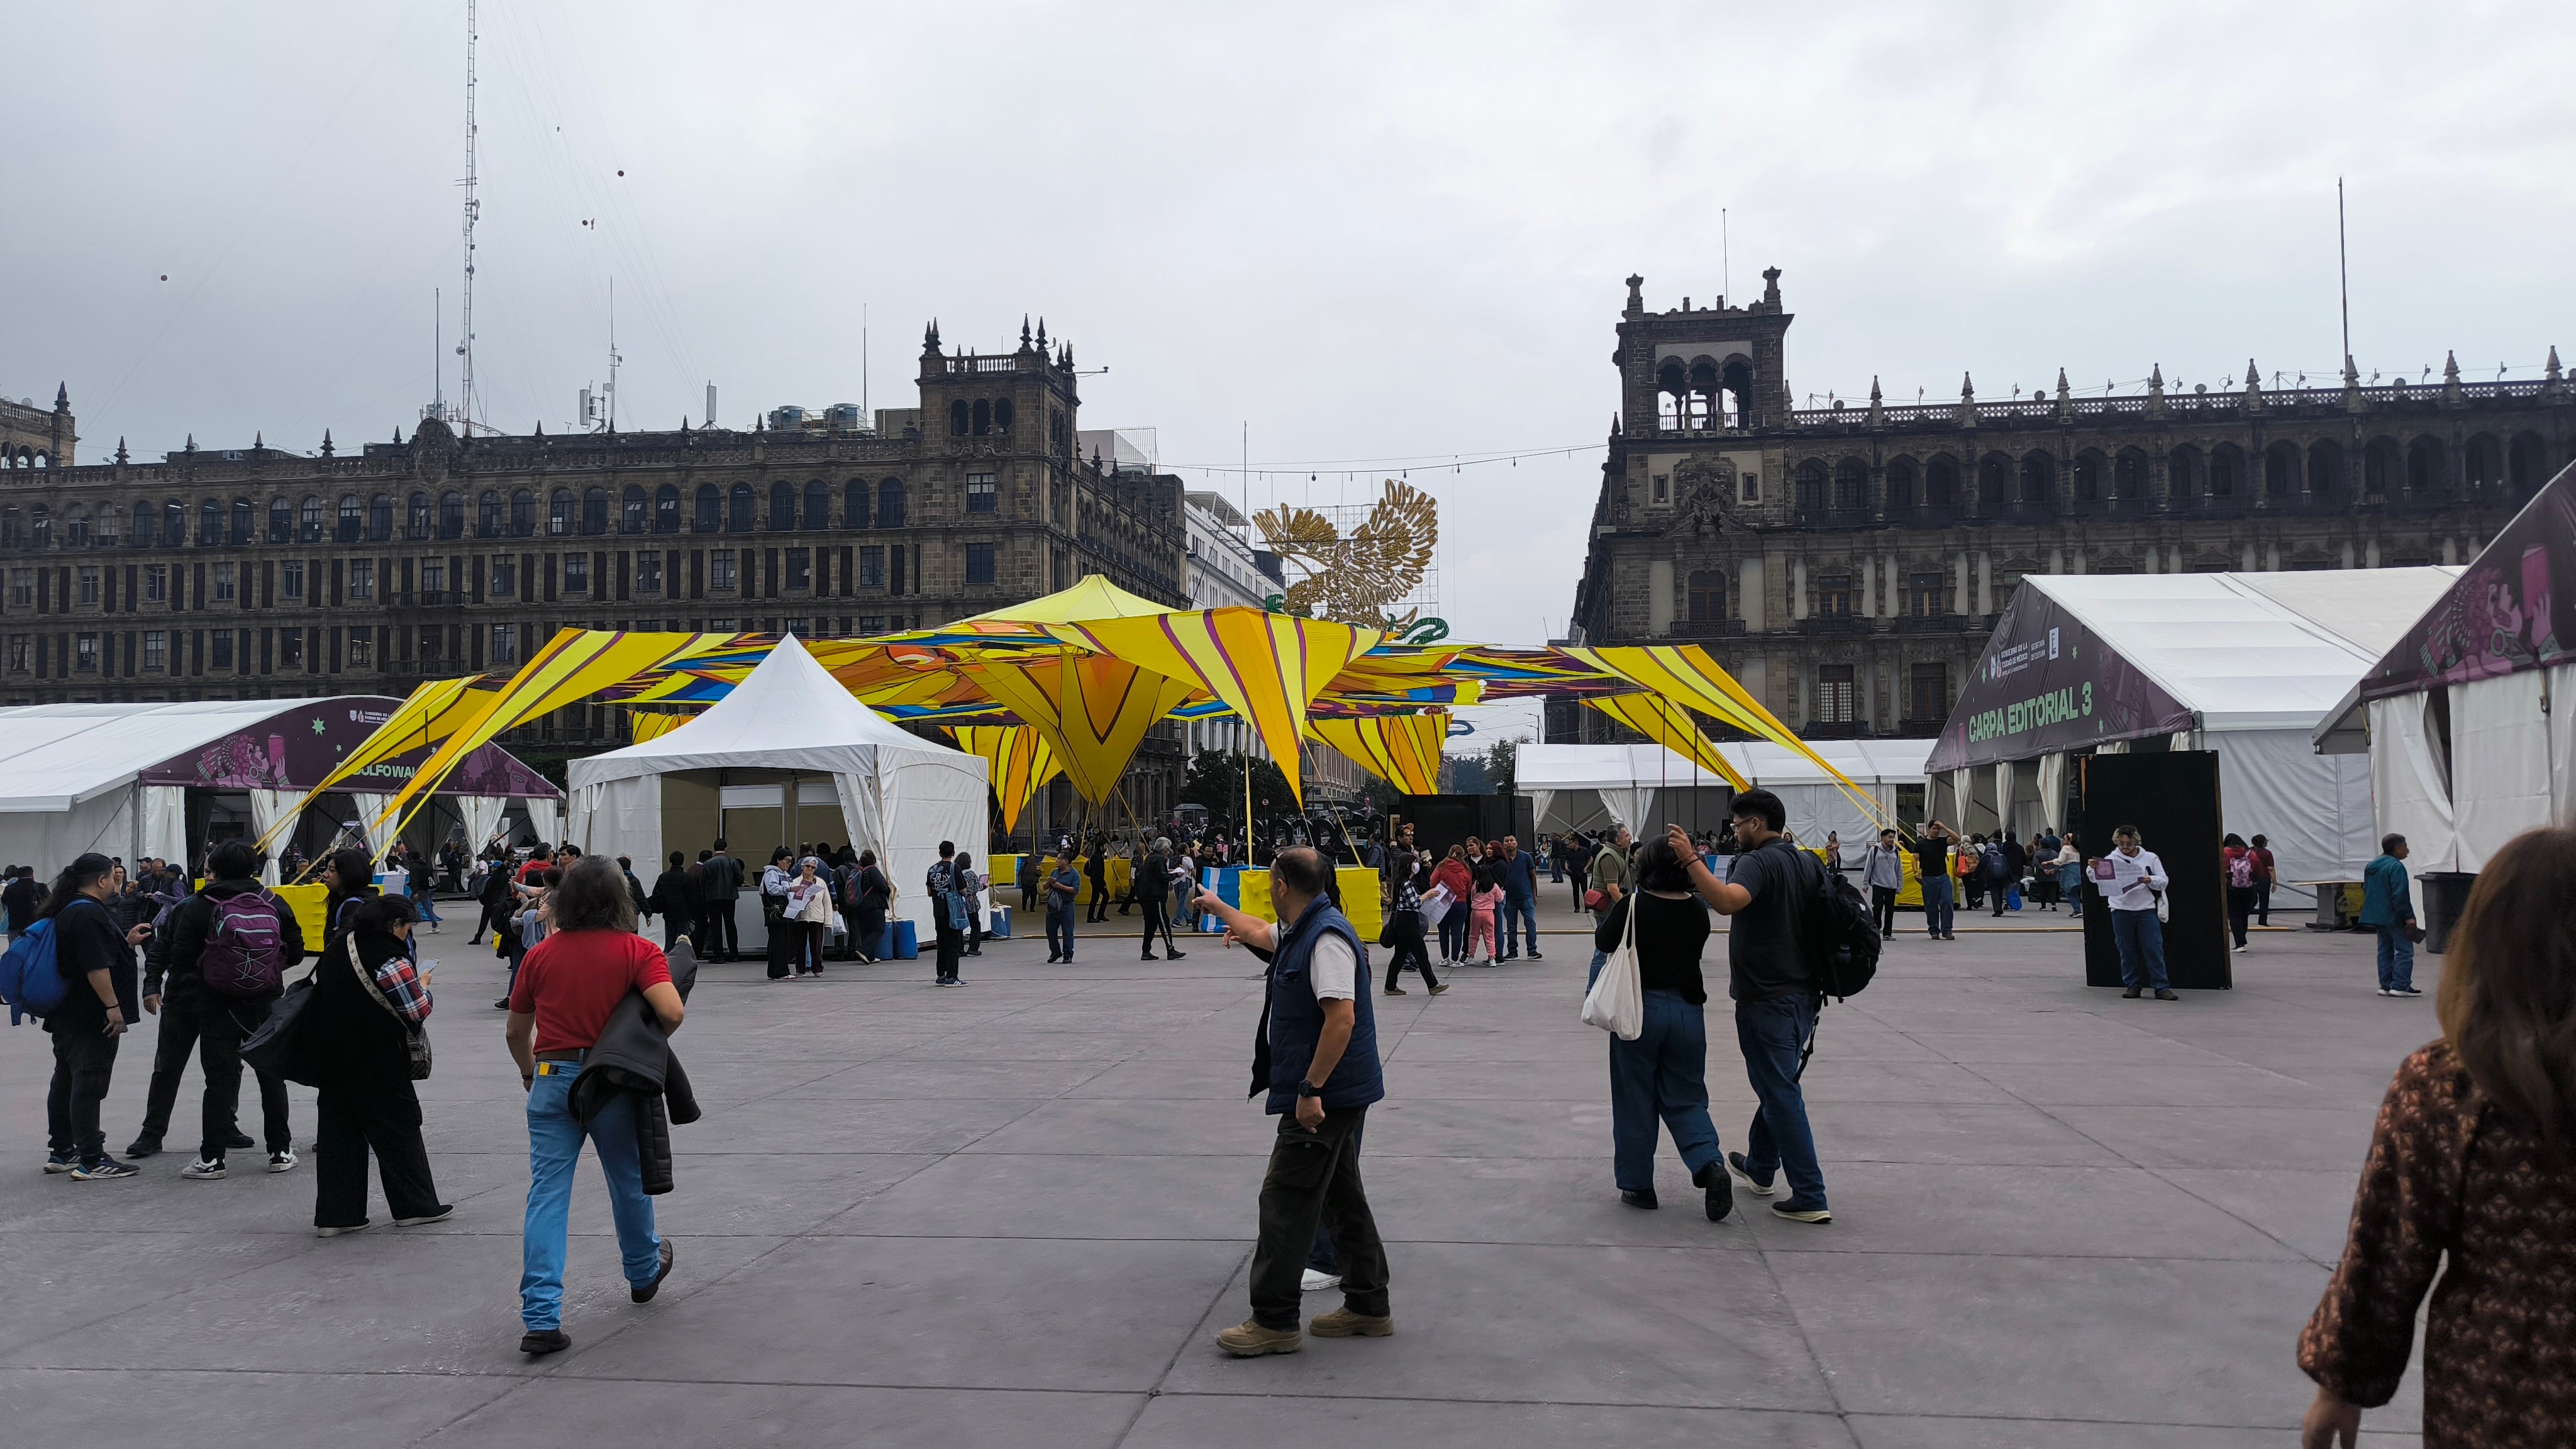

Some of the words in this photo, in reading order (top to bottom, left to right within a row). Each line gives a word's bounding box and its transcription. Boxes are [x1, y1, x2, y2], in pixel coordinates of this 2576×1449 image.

[2001, 645, 2018, 658] GOBIERNO
[2018, 643, 2023, 652] DE
[2023, 641, 2028, 650] LA
[1968, 708, 2006, 743] CARPA
[2007, 686, 2079, 735] EDITORIAL
[2082, 681, 2092, 716] 3
